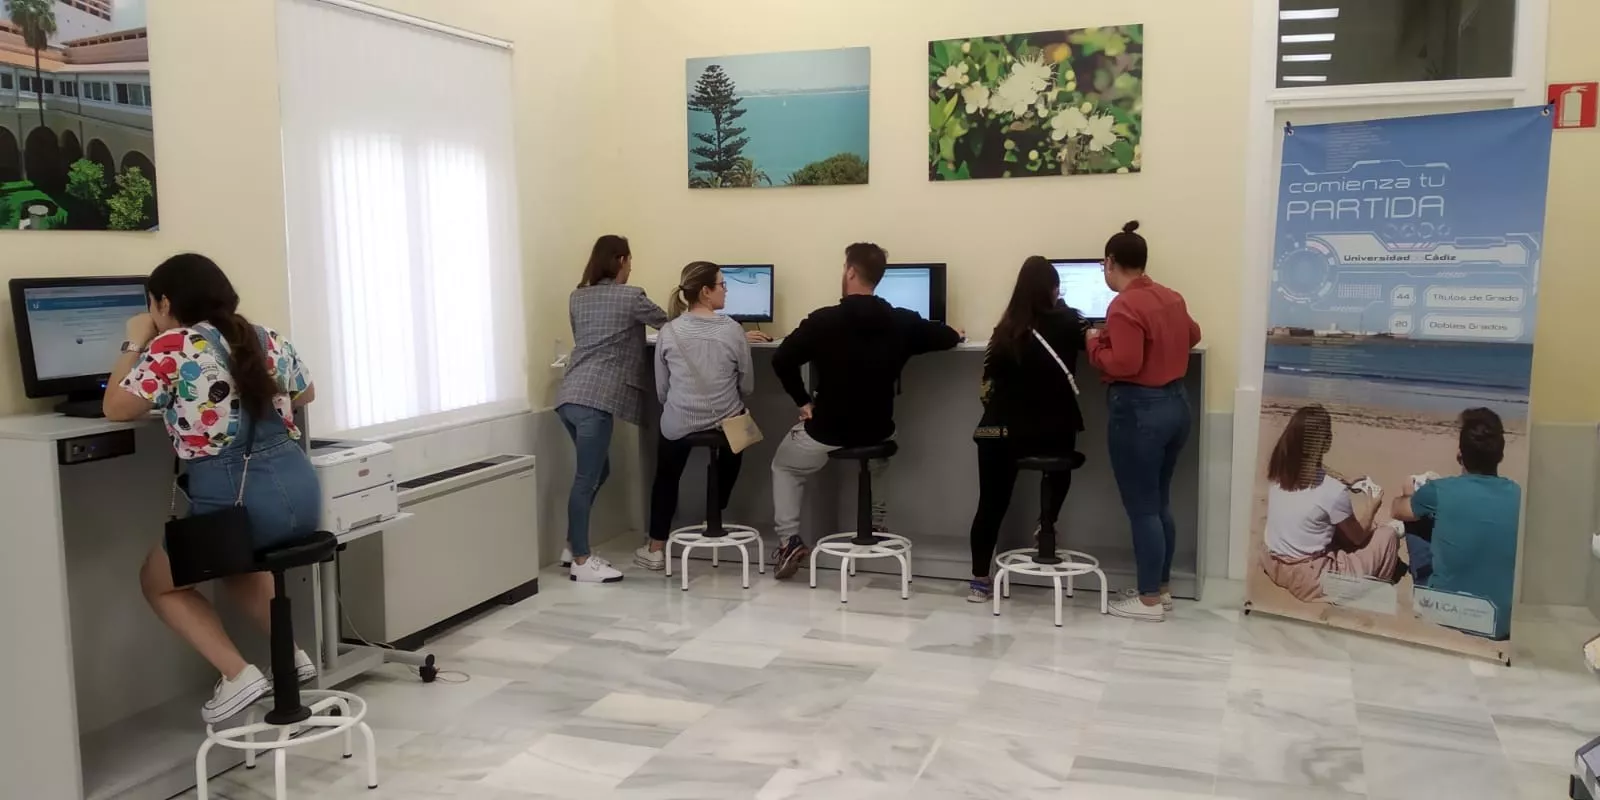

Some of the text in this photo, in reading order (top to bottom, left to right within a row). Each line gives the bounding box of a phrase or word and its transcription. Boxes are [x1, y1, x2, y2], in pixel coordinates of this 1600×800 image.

[1288, 172, 1446, 194] comienza tu
[1286, 196, 1445, 221] PARTIDA
[1343, 254, 1410, 262] Universidad
